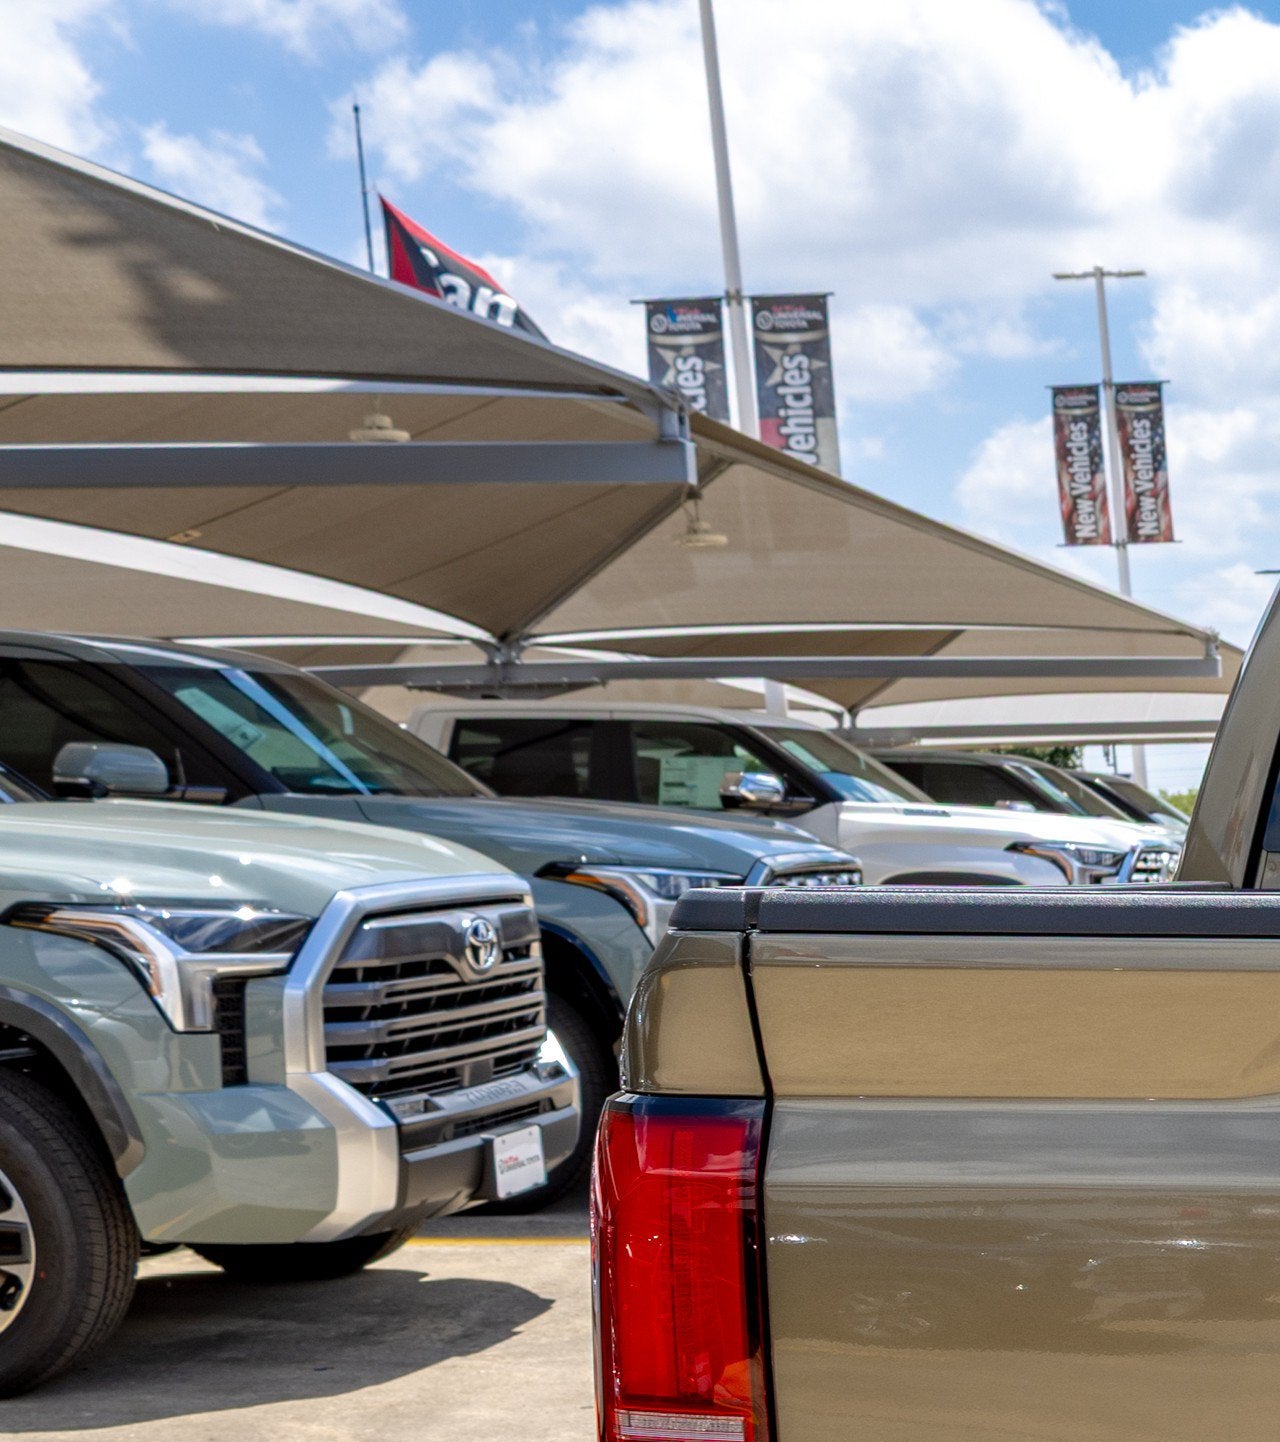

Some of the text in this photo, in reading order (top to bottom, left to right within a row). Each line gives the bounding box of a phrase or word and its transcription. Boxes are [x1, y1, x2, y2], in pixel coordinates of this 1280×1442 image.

[1066, 421, 1093, 496] Vehicles
[1130, 418, 1156, 494] Vehicles
[1075, 499, 1098, 538] New
[1137, 496, 1160, 536] New
